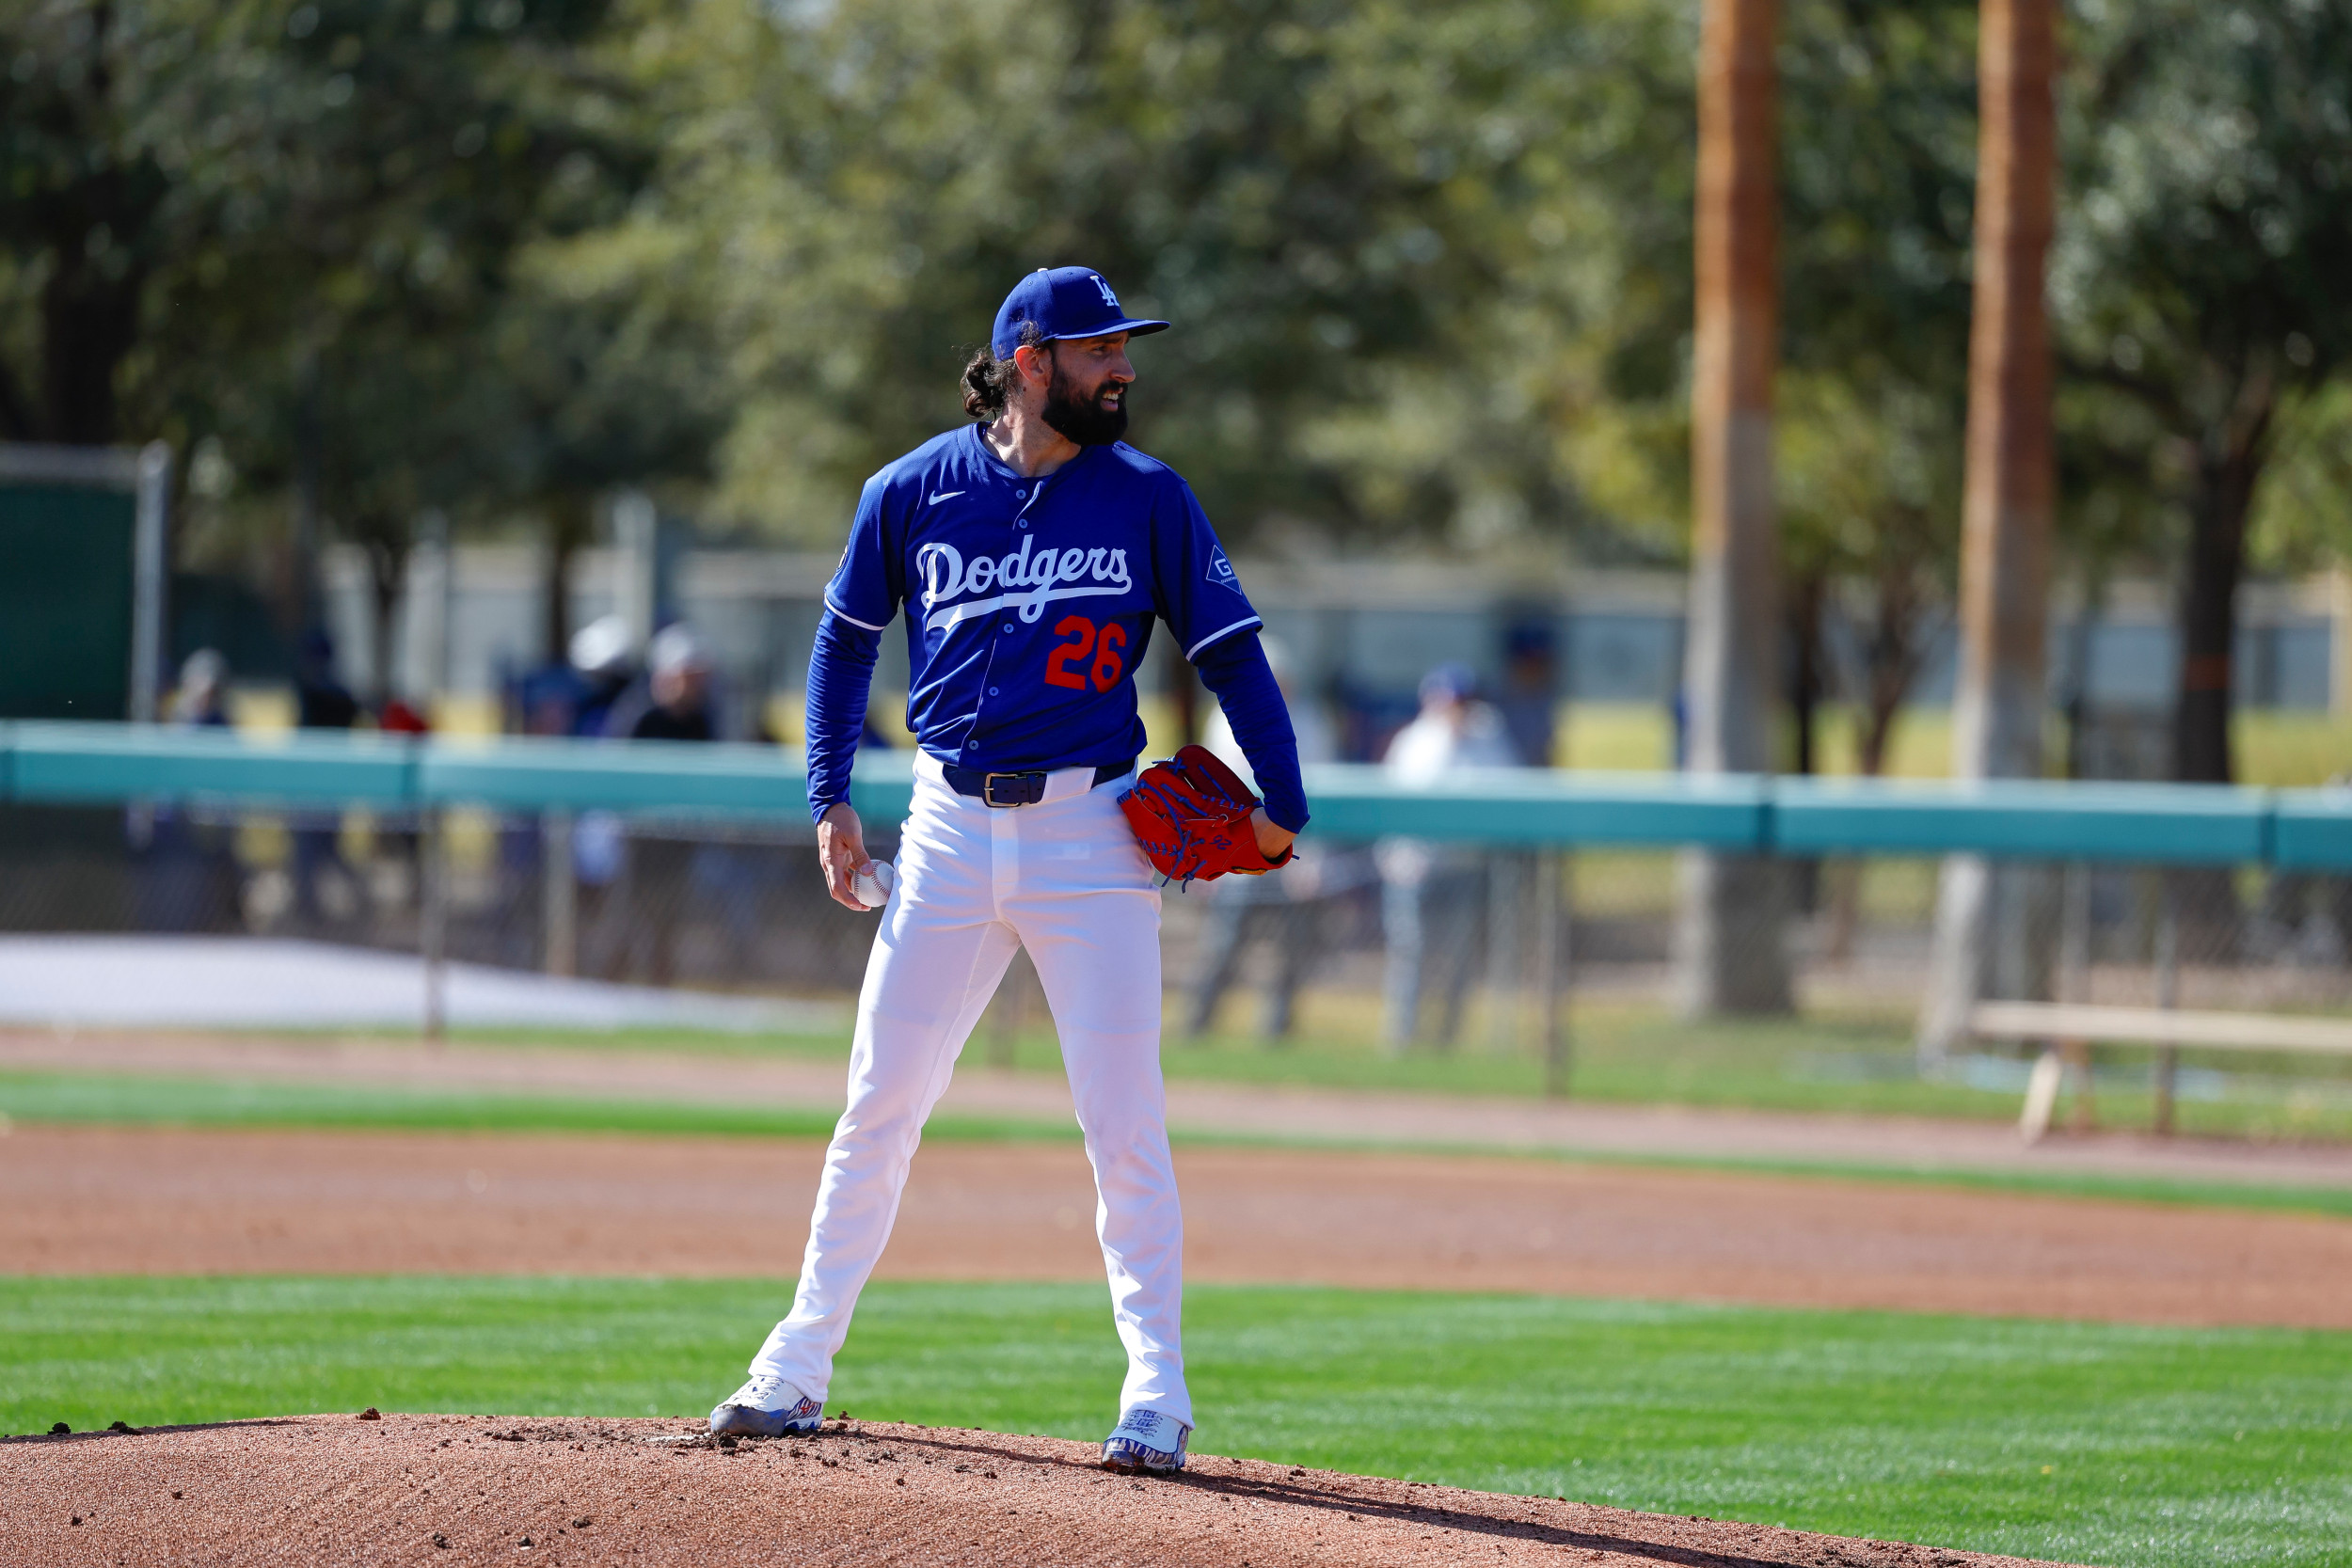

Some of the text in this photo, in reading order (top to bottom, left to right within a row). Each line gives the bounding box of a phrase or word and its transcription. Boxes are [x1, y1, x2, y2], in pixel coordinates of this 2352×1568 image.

[1089, 275, 1120, 307] LA
[915, 533, 1132, 624] Dodgers
[1214, 558, 1232, 577] G
[1044, 614, 1127, 693] 26
